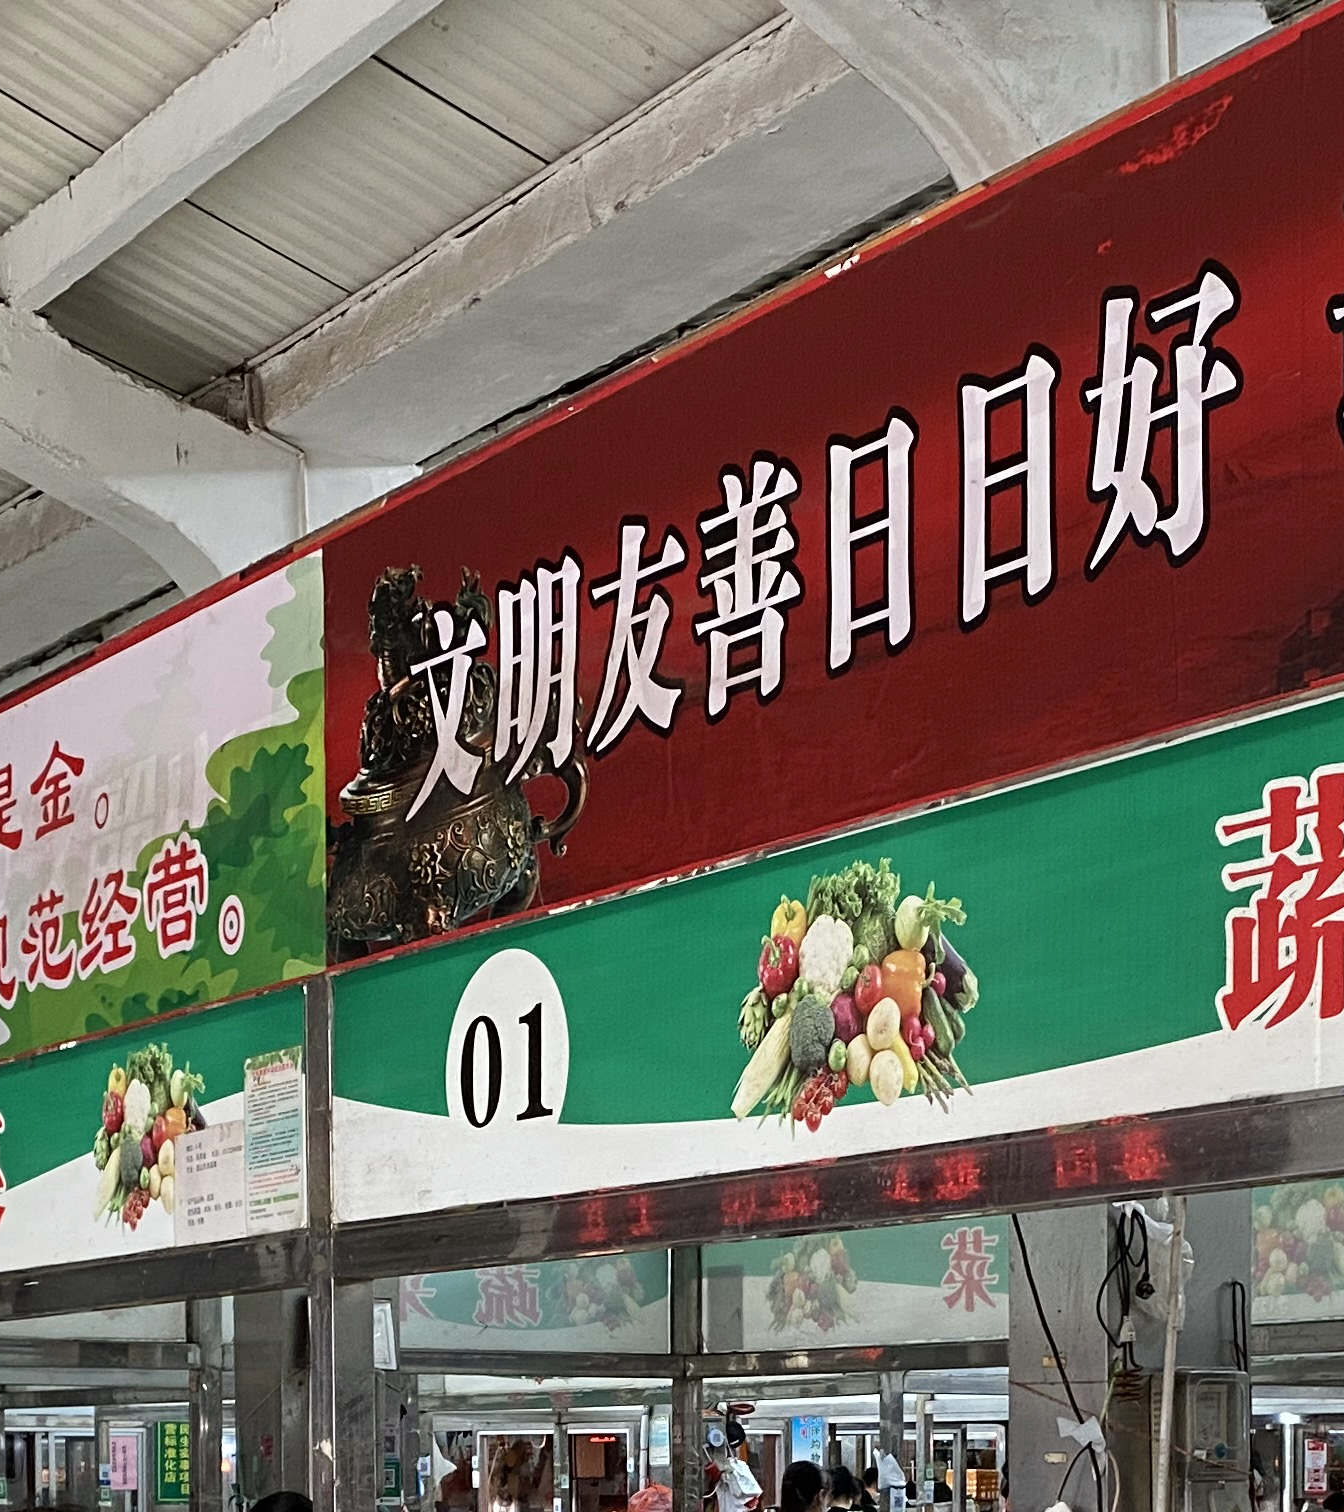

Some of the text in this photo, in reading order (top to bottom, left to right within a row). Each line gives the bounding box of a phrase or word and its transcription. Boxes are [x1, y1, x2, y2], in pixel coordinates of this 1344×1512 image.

[407, 270, 1236, 821] 文明友善日日好
[459, 1003, 553, 1129] 01
